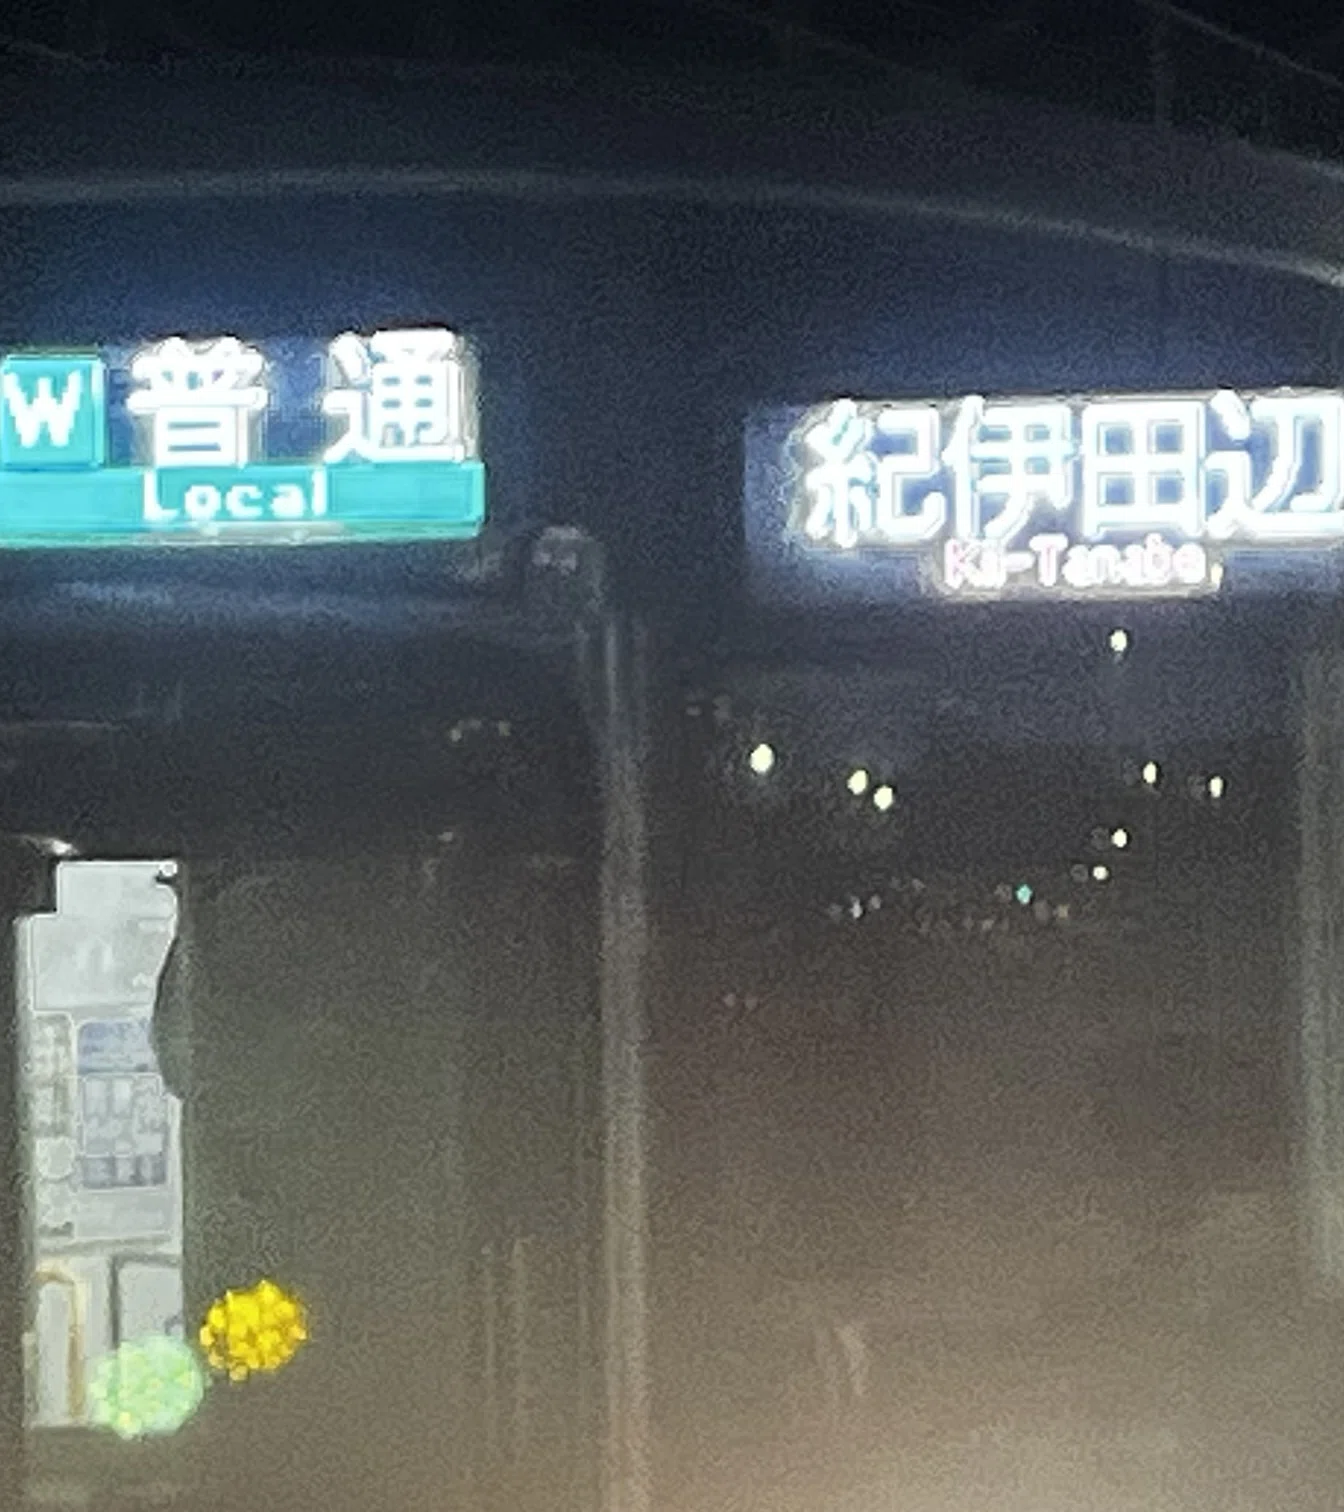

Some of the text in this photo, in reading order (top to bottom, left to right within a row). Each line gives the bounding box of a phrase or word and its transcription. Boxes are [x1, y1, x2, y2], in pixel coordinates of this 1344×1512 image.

[2, 370, 85, 449] W
[126, 328, 468, 468] 普通
[143, 470, 329, 521] Local
